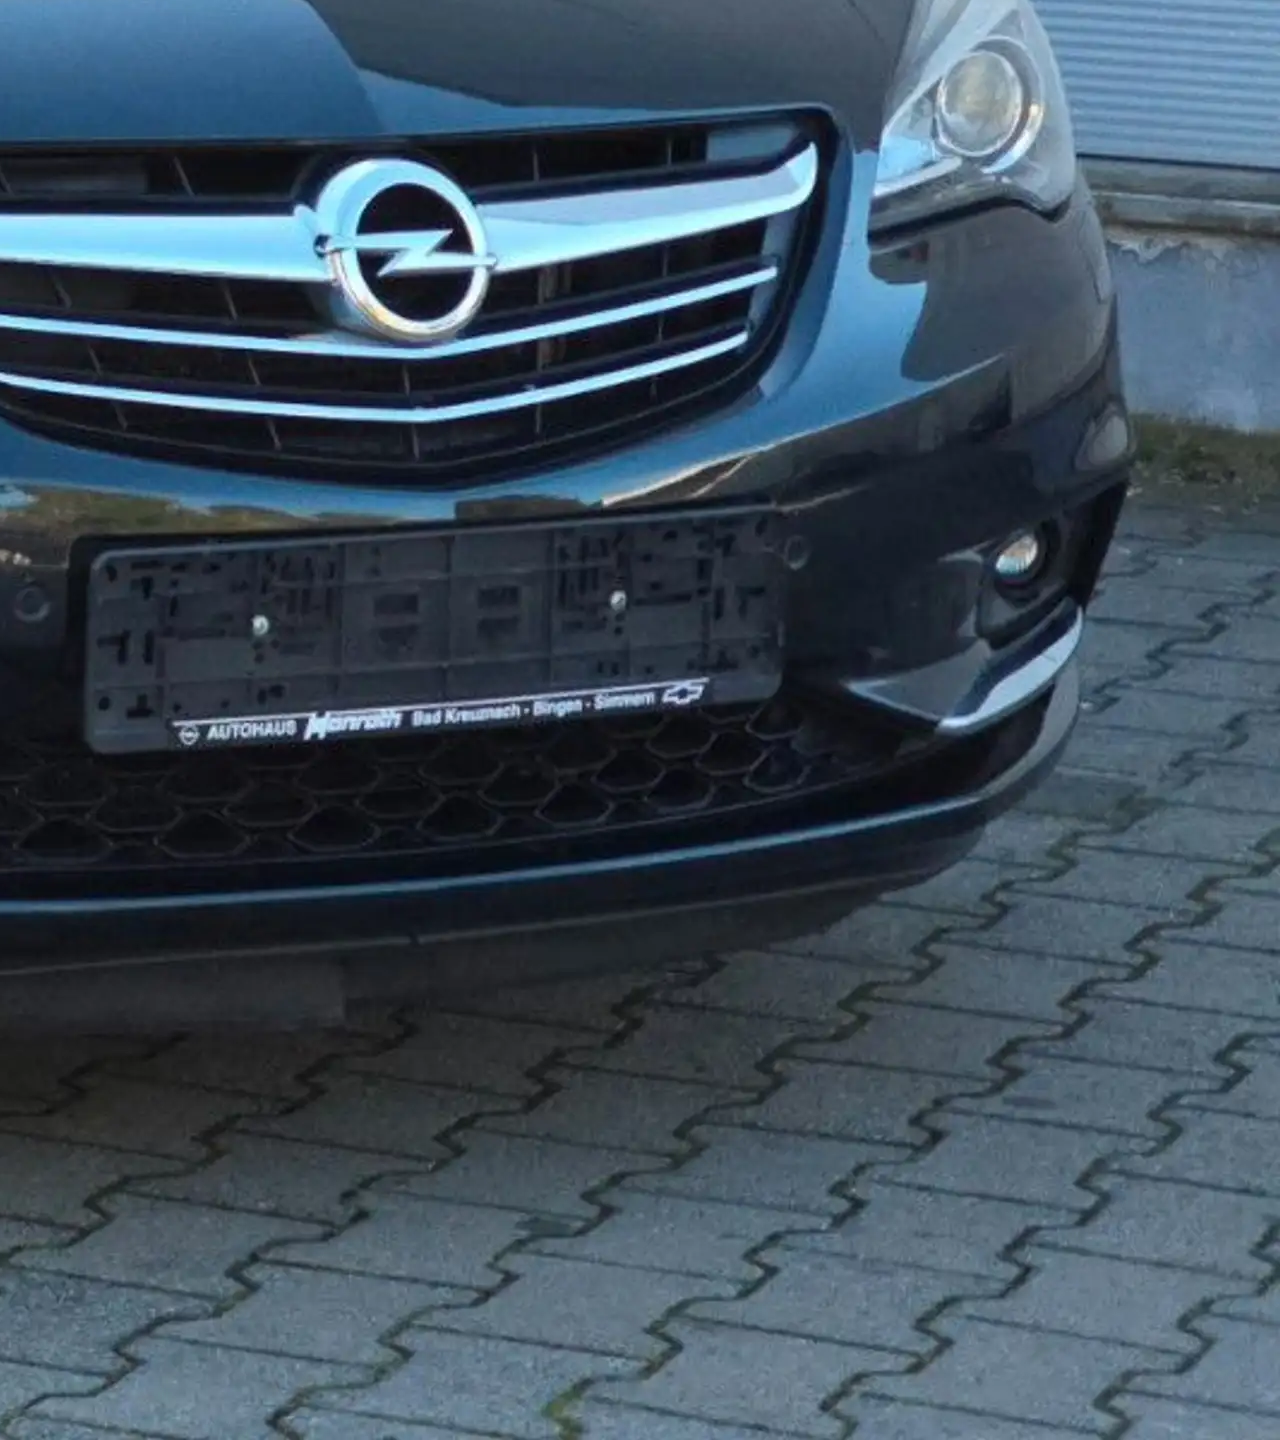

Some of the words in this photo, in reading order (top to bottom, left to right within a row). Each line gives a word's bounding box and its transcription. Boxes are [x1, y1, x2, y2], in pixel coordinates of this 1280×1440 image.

[206, 720, 297, 741] AUTOHAUS
[412, 710, 442, 727] Bad
[444, 703, 521, 724] Kreuznach
[533, 698, 583, 717] Bingen
[594, 691, 656, 711] Simmern
